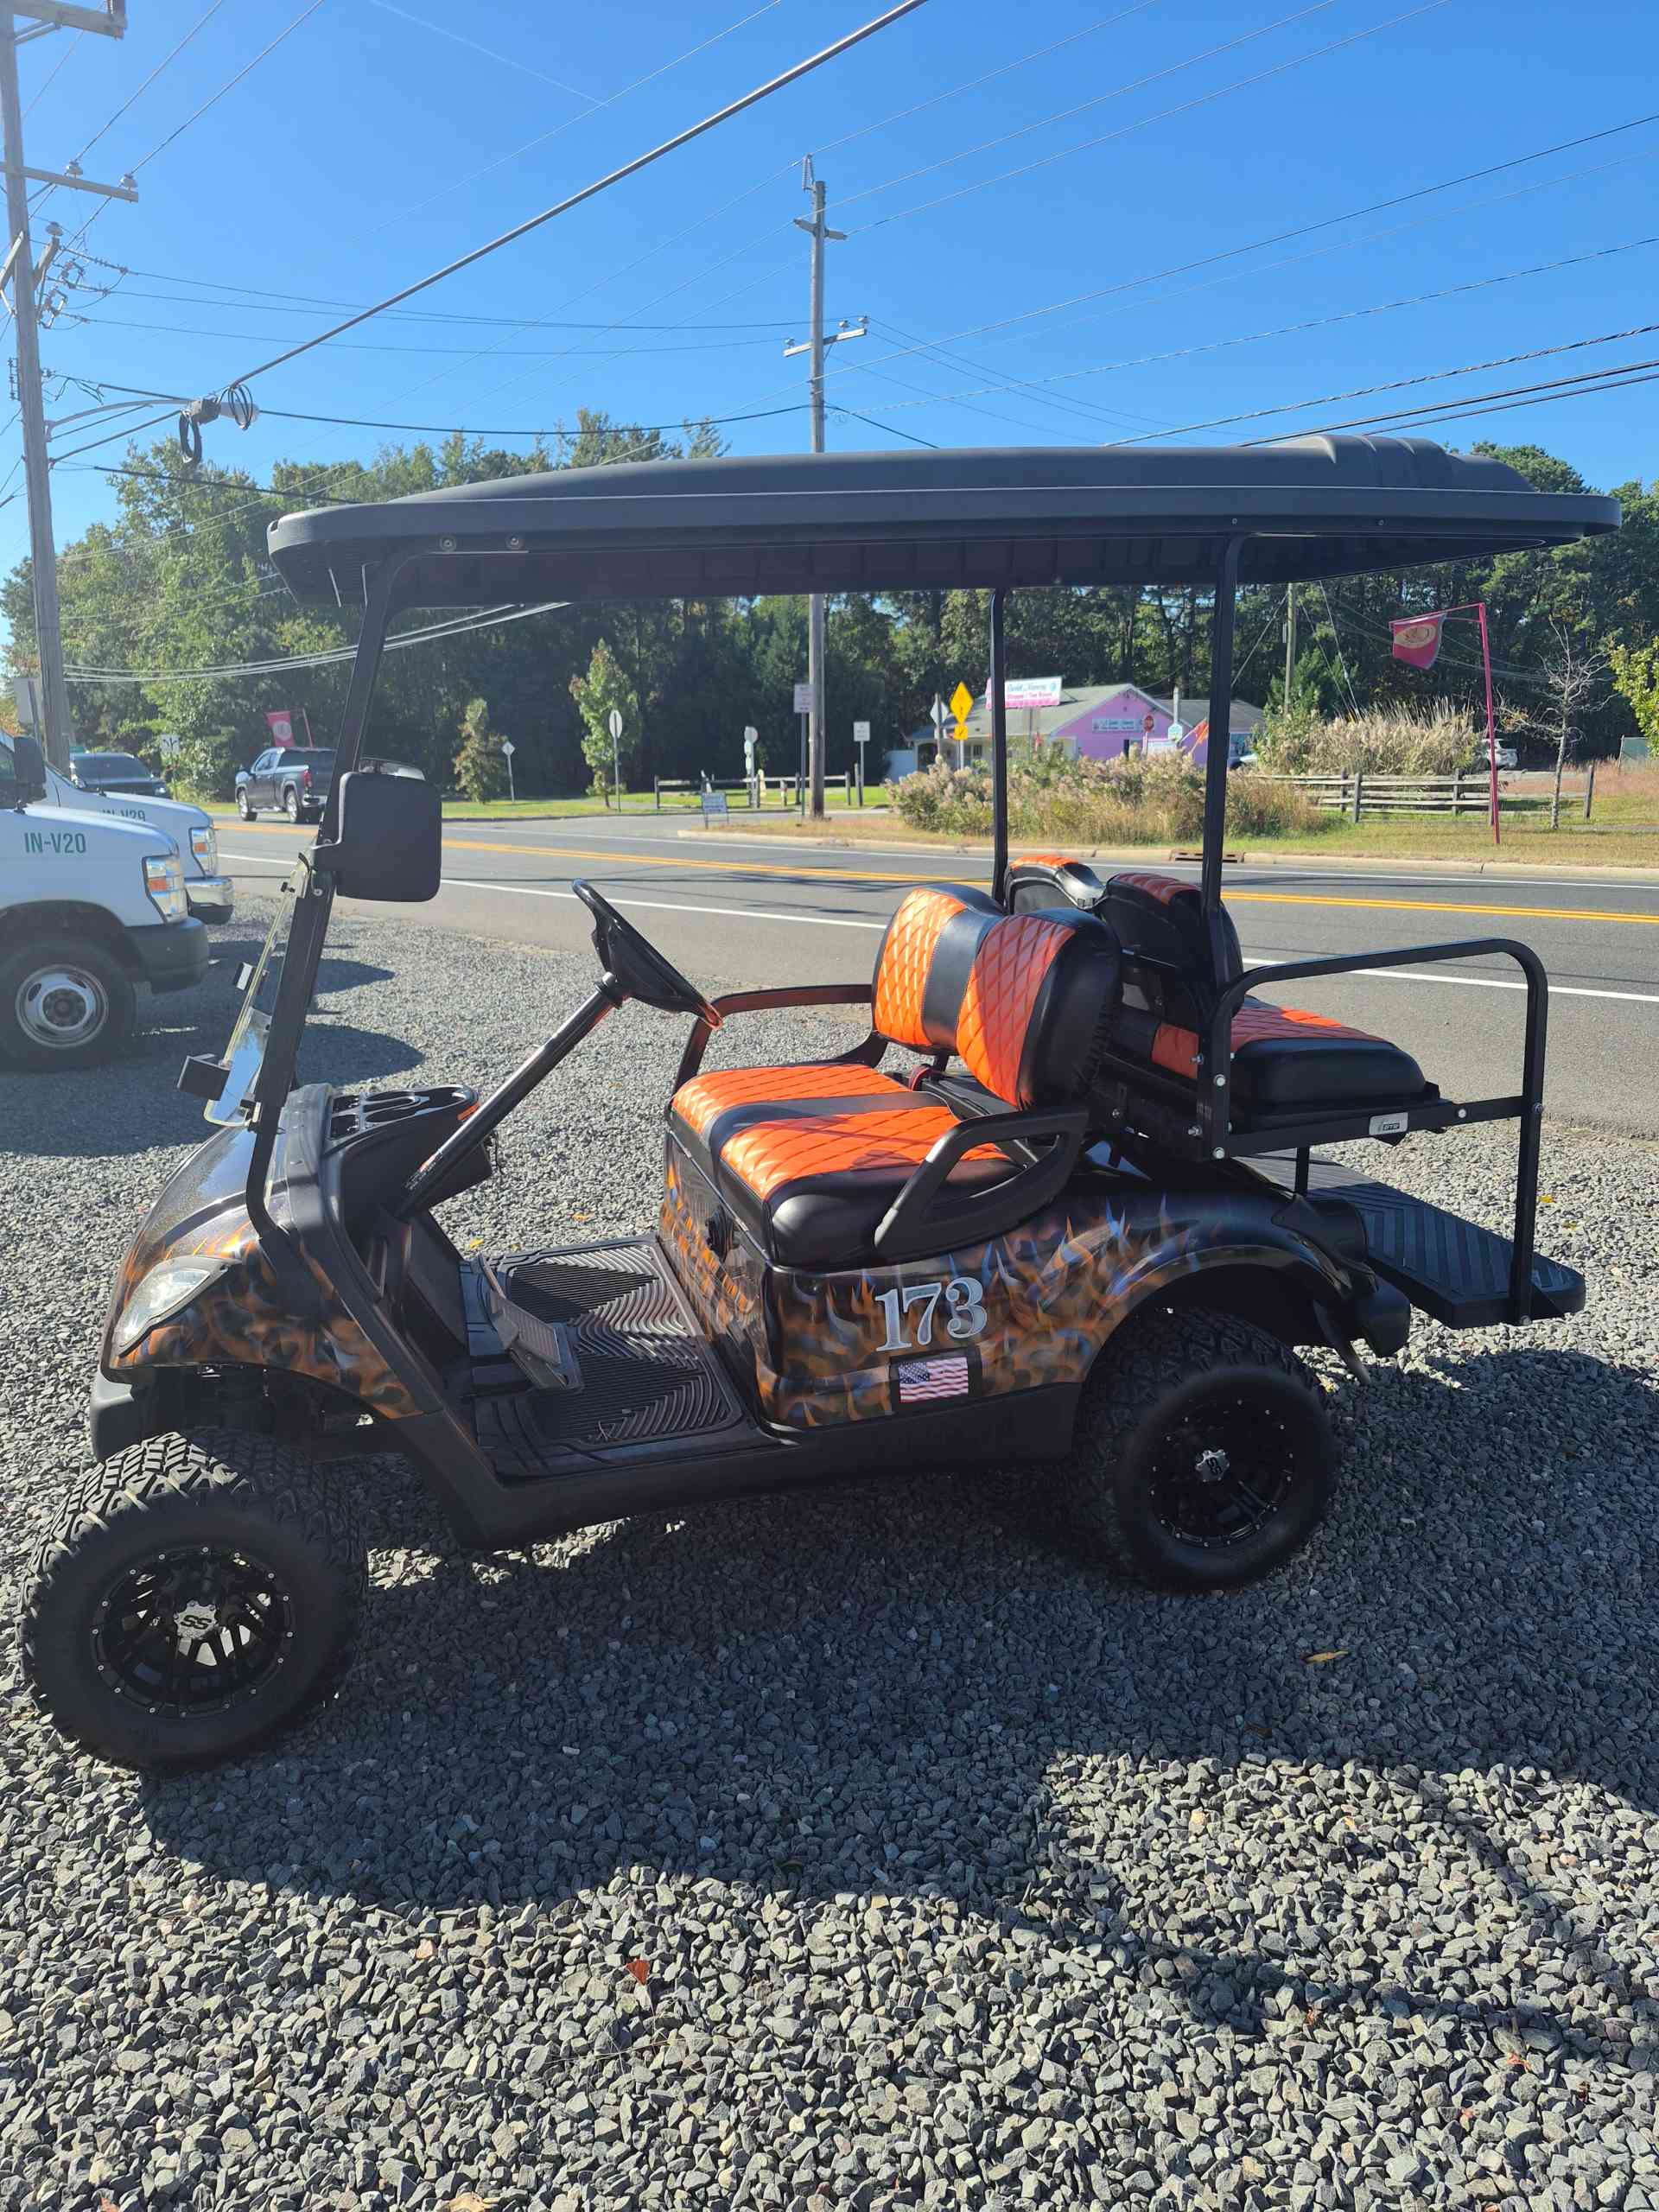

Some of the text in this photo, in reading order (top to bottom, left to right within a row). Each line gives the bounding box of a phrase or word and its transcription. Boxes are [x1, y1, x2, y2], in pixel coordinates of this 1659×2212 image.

[24, 832, 86, 854] IN-V20
[874, 1276, 988, 1352] 173
[180, 1614, 213, 1630] SS
